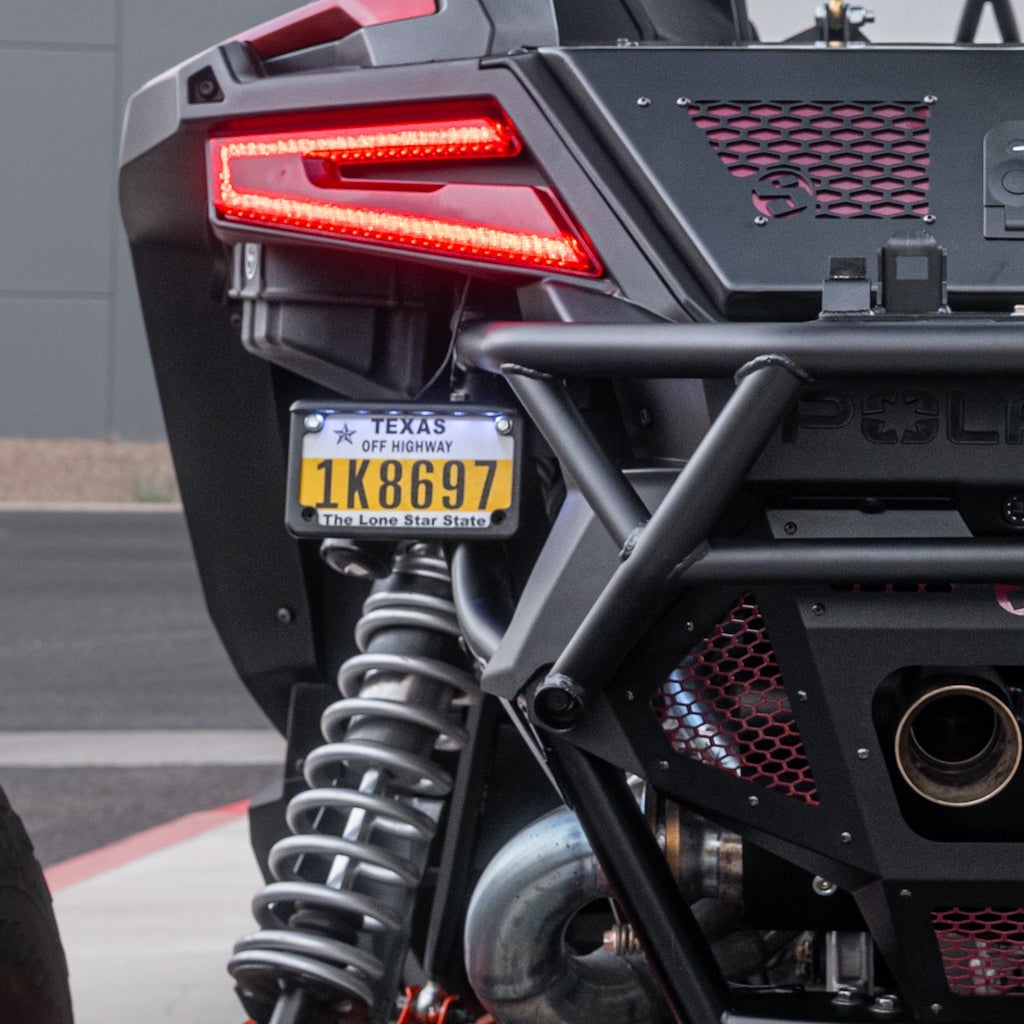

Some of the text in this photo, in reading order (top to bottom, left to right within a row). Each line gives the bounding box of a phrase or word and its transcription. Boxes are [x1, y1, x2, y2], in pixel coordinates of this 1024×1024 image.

[371, 417, 446, 435] TEXAS
[361, 439, 453, 453] OFF HIGHWAY
[315, 459, 498, 510] 1K8697
[323, 514, 486, 527] The Lone Star State
